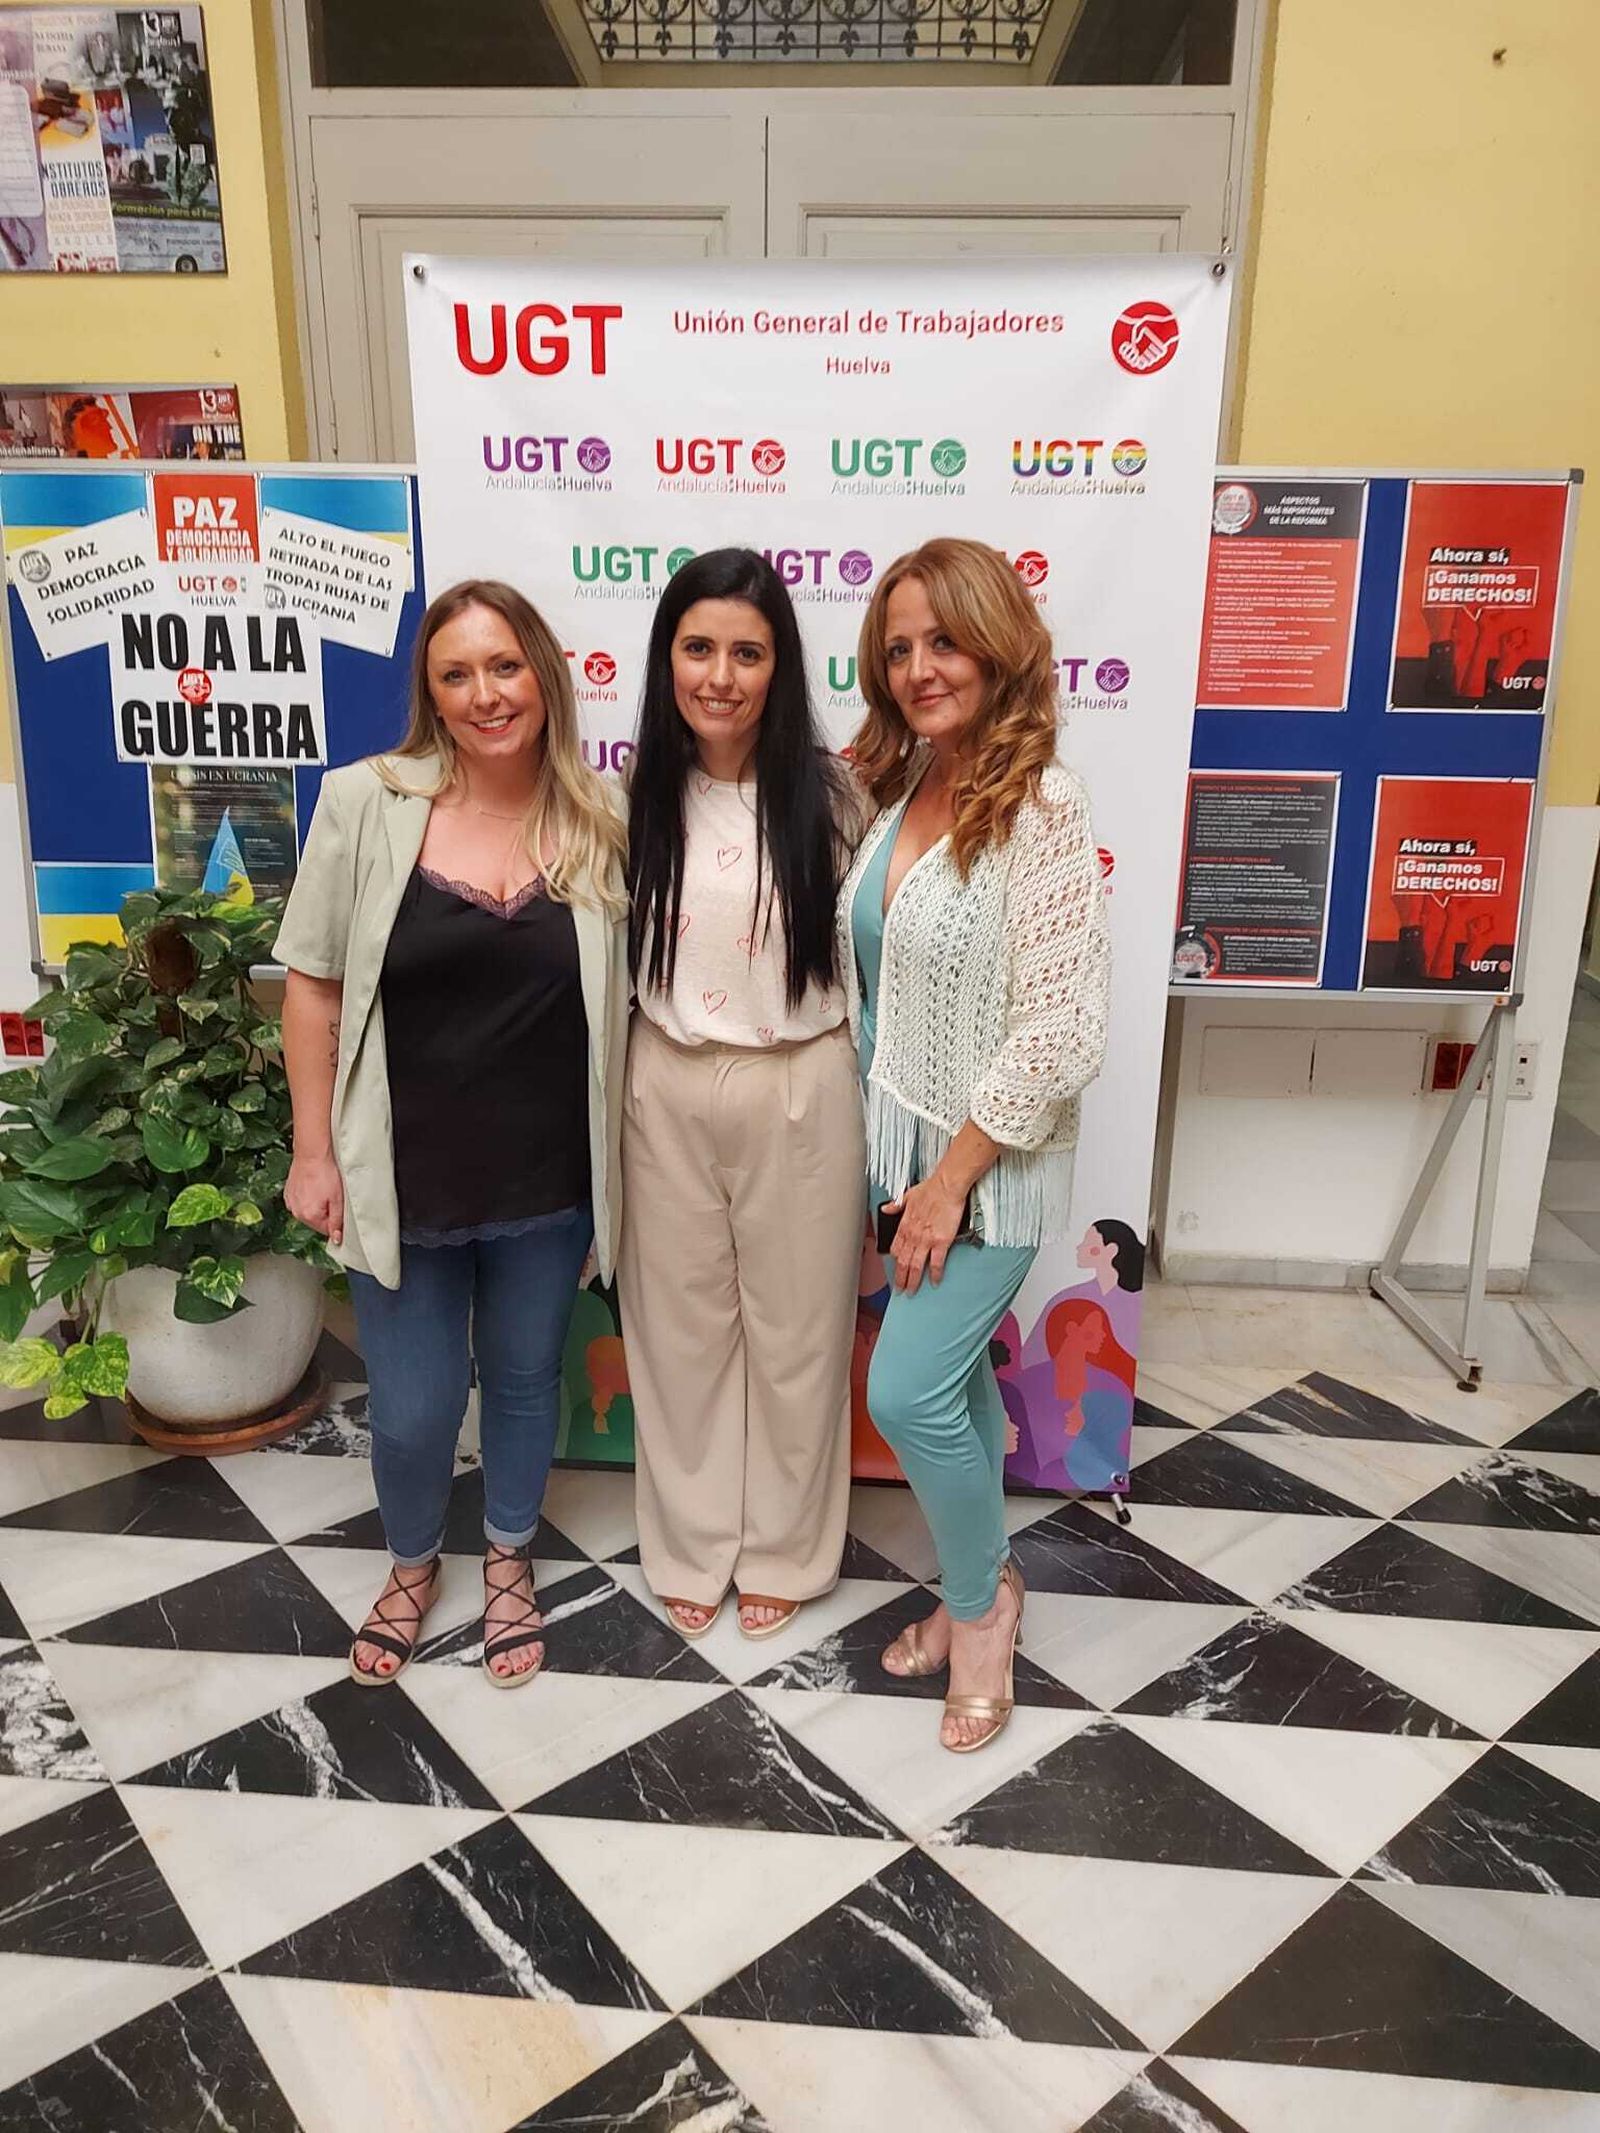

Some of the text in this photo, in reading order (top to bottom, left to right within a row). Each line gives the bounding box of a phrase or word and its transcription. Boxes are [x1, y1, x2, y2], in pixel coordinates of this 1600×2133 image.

[674, 310, 1064, 339] Unión General de Trabajadores
[454, 303, 623, 376] UGT
[826, 356, 891, 375] Huelva
[483, 436, 569, 473] UGT
[656, 438, 743, 475] UGT
[831, 439, 923, 477] UGT
[1012, 439, 1103, 478] UGT
[173, 496, 239, 529] PAZ
[166, 529, 251, 546] DEMOCRACIA
[279, 528, 391, 568] ALTO EL FUEGO
[64, 542, 99, 563] PAZ
[177, 546, 255, 562] SOLIDARIDAD
[572, 546, 658, 582] UGT
[1430, 547, 1510, 566] Ahora sí,
[38, 555, 146, 600] DEMOCRACIA
[269, 547, 392, 591] RETIRADA DE LAS
[1428, 570, 1517, 587] ¡Ganamos
[178, 575, 218, 592] UGT
[266, 567, 321, 591] TROPAS
[324, 583, 367, 605] RUSAS
[370, 597, 390, 611] DE
[1427, 588, 1532, 603] DERECHOS!
[47, 579, 155, 624] SOLIDARIDAD
[191, 595, 237, 606] HUELVA
[121, 613, 307, 673] NO A LA
[1502, 676, 1533, 690] UGT
[121, 700, 319, 759] GUERRA
[226, 770, 277, 783] UCRANIA
[1399, 839, 1476, 856] Ahora sí,
[1398, 860, 1483, 875] ¡Ganamos
[1396, 876, 1498, 891] DERECHOS!
[1470, 960, 1499, 972] UGT
